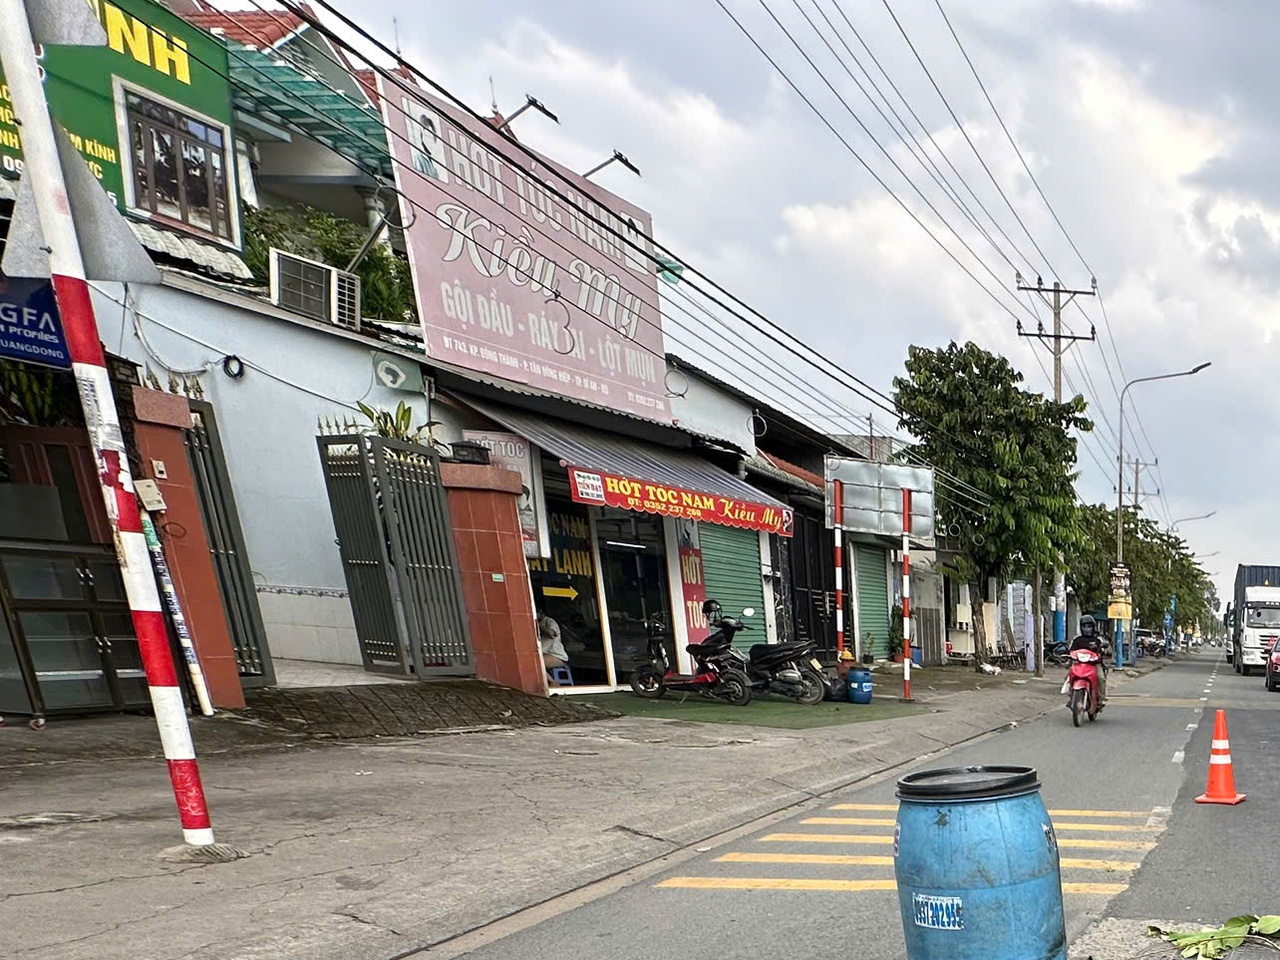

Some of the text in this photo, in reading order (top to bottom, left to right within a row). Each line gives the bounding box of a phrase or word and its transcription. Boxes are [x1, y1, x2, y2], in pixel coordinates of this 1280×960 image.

[435, 203, 561, 298] Kiều
[441, 279, 475, 330] GỘI
[478, 288, 514, 337] ĐẦU
[0, 340, 65, 359] UANGDONG
[605, 477, 642, 498] HỚT
[645, 485, 679, 504] TÓC
[681, 492, 715, 511] NAM
[644, 500, 666, 510] 0352
[668, 505, 684, 513] 237
[682, 552, 702, 585] HỚT
[687, 595, 706, 629] TÓC
